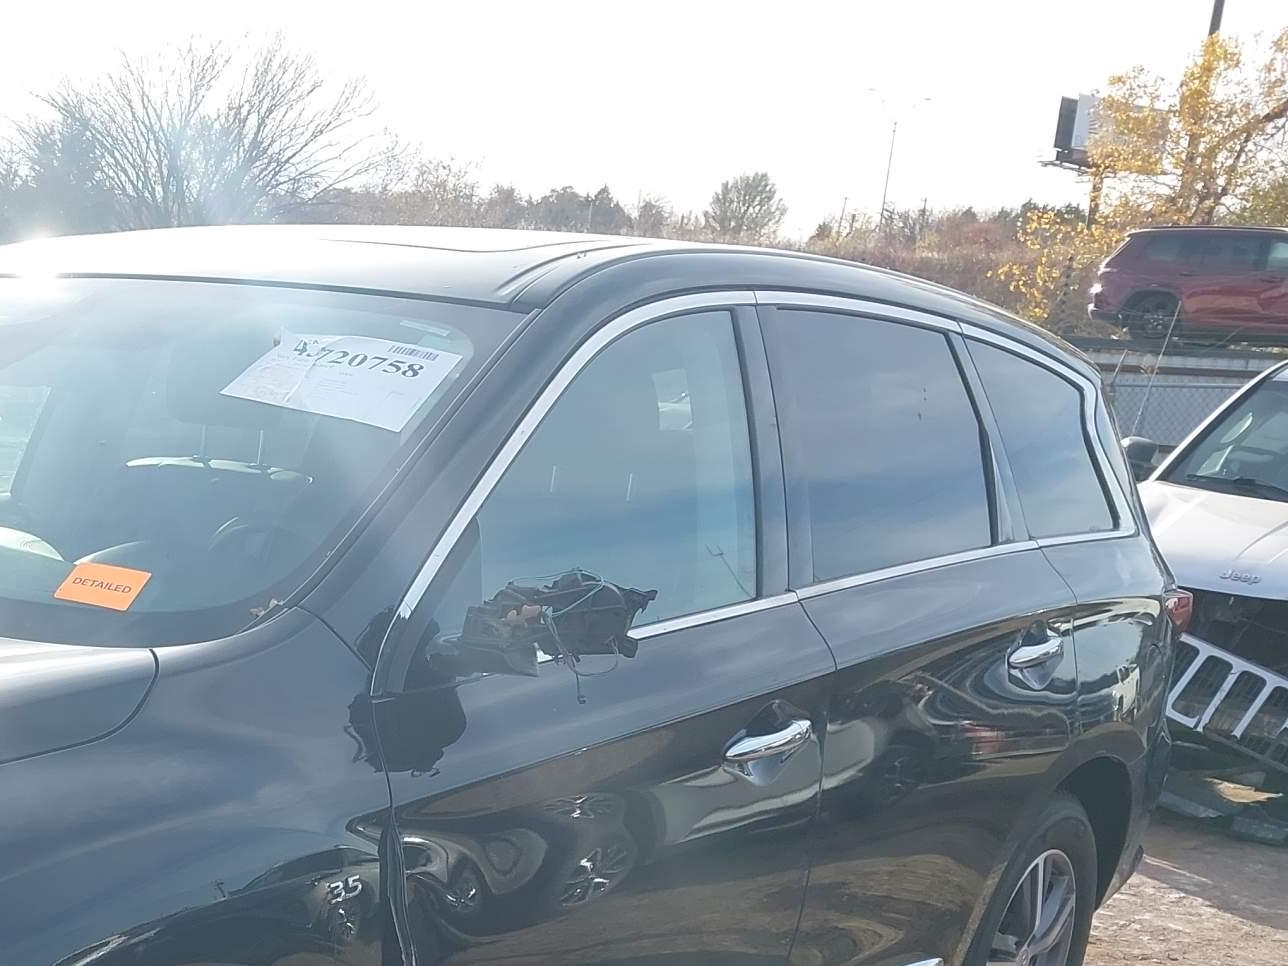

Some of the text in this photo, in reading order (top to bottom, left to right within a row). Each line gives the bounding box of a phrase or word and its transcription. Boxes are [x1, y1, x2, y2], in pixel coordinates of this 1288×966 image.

[71, 576, 132, 594] DETAILED
[1219, 568, 1263, 586] Jeep
[328, 874, 363, 905] 35
